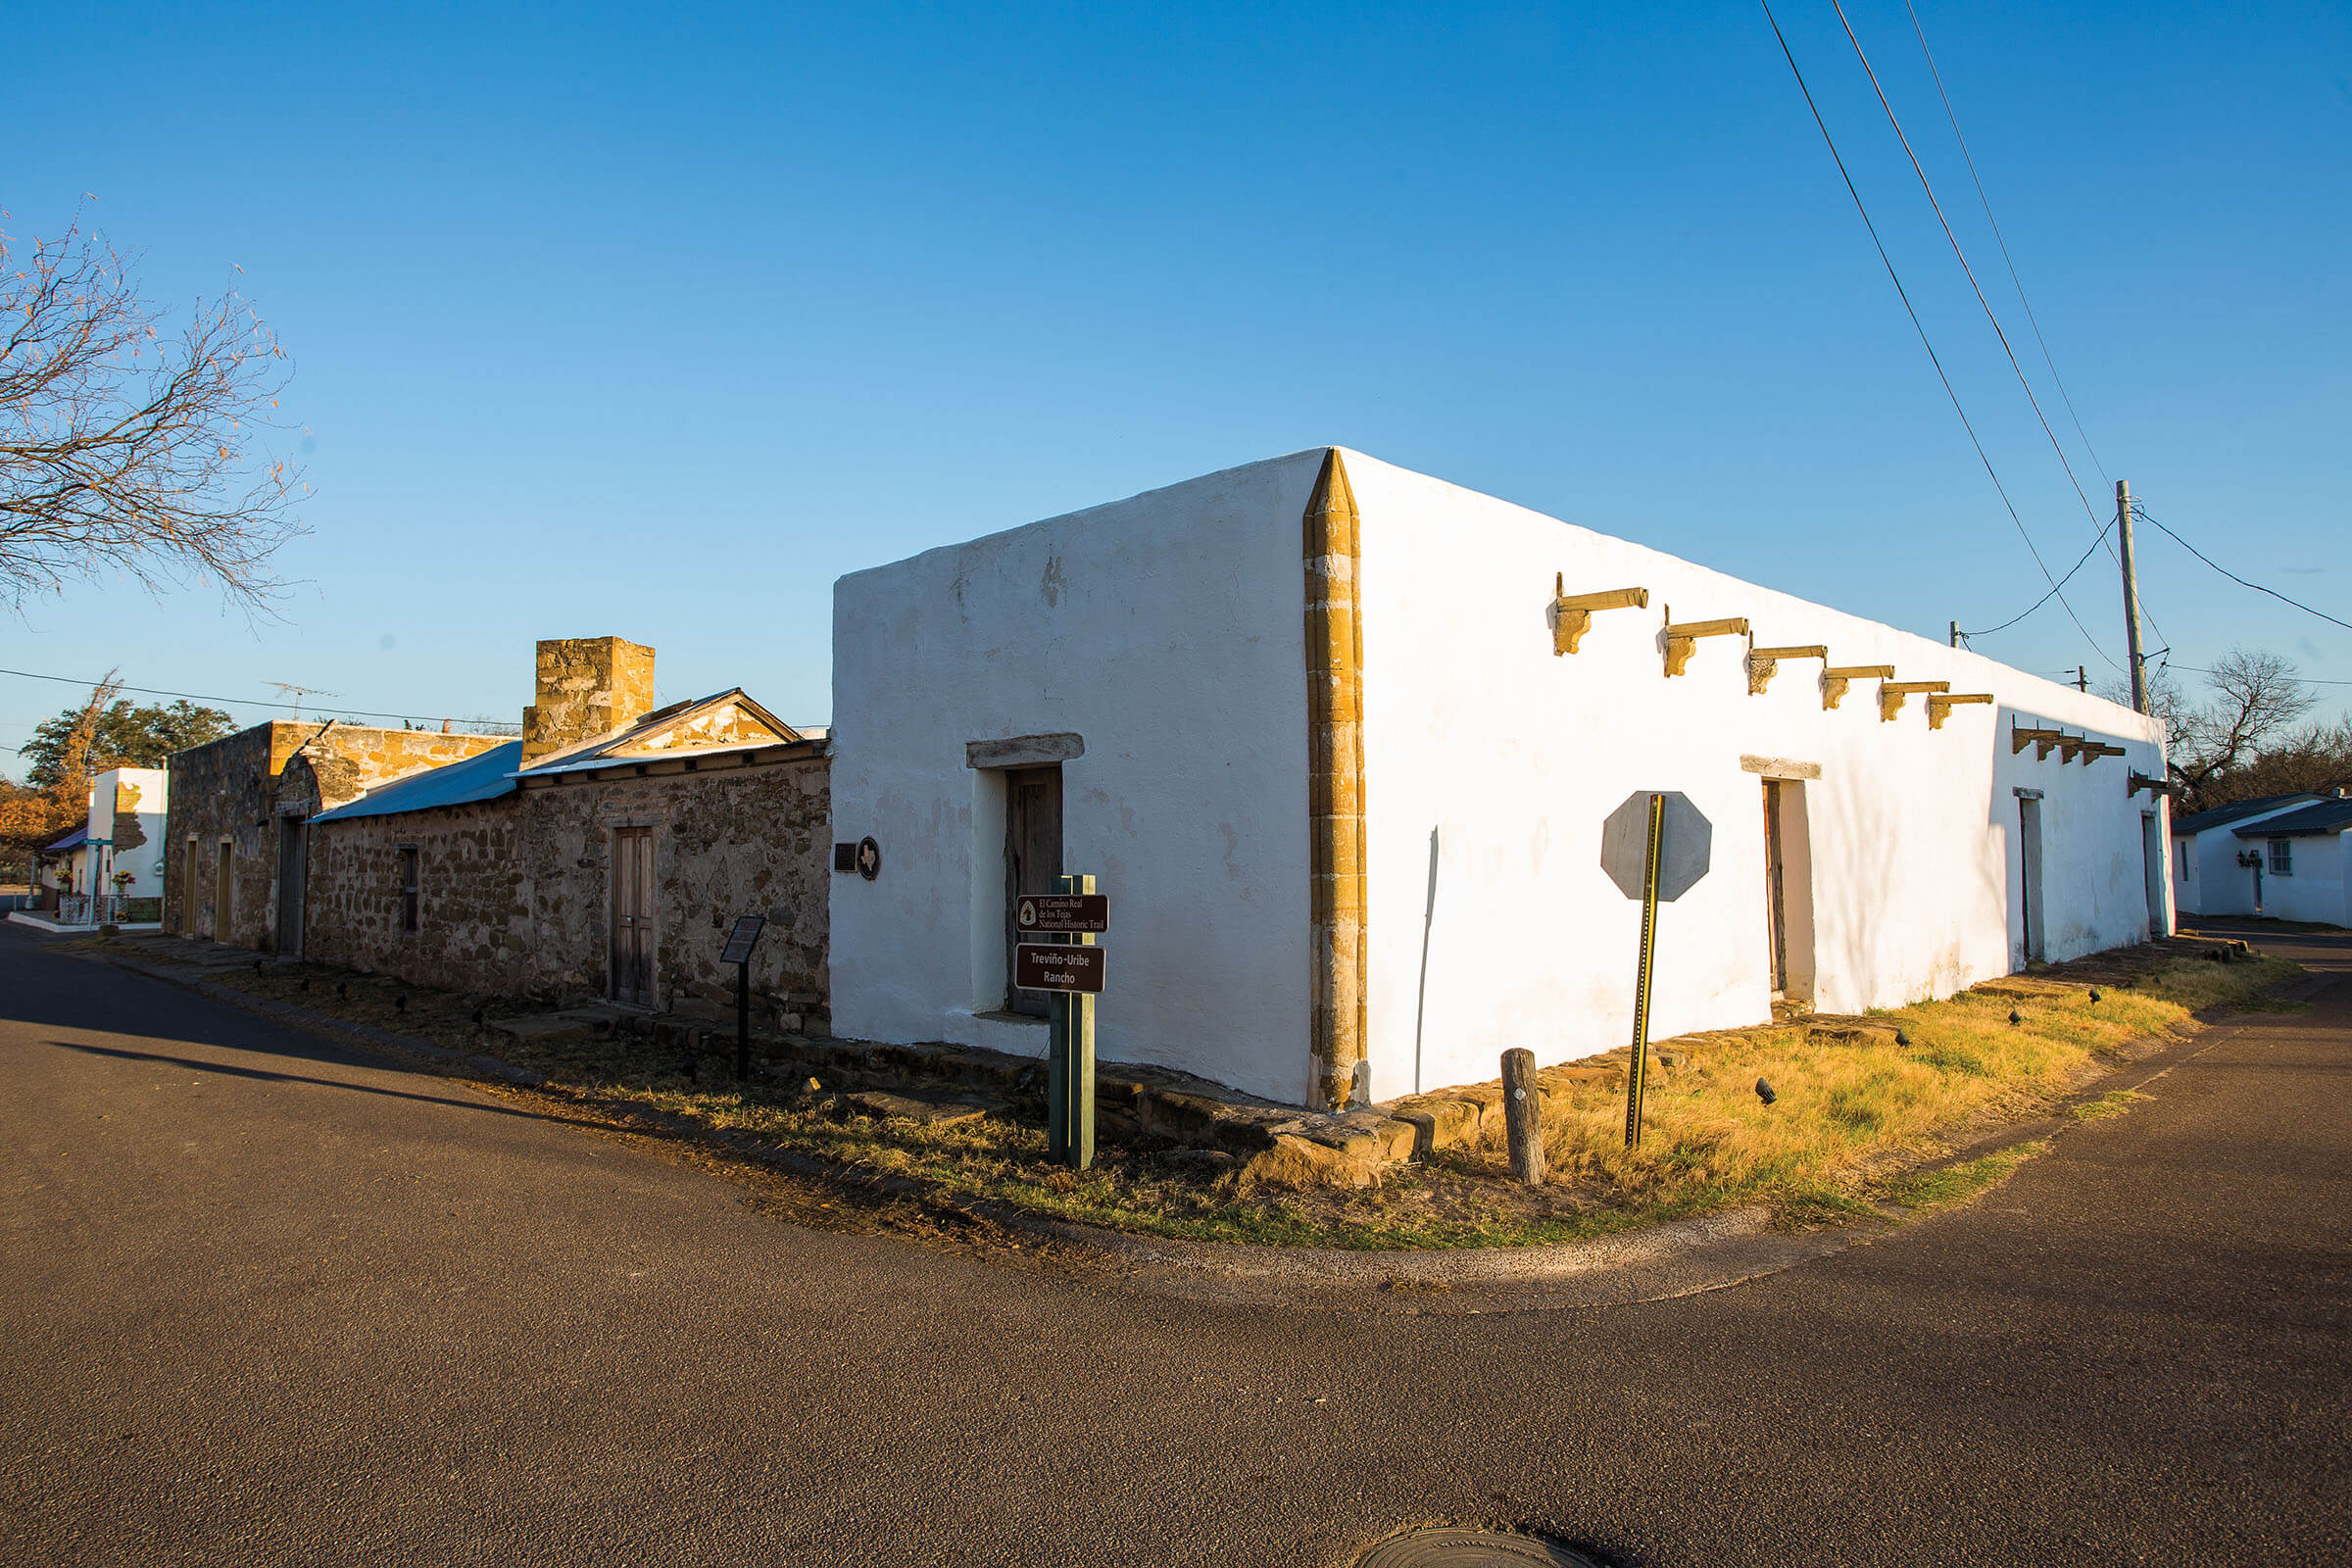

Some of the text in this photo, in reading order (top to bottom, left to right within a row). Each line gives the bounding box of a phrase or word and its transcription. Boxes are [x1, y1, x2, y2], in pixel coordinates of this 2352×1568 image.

[1039, 899, 1082, 908] El Camino Real
[1039, 909, 1071, 920] de los Tejas
[1039, 919, 1104, 929] National Historic Trail
[1030, 953, 1090, 966] Treviño-Uribe
[1044, 971, 1075, 984] Rancho
